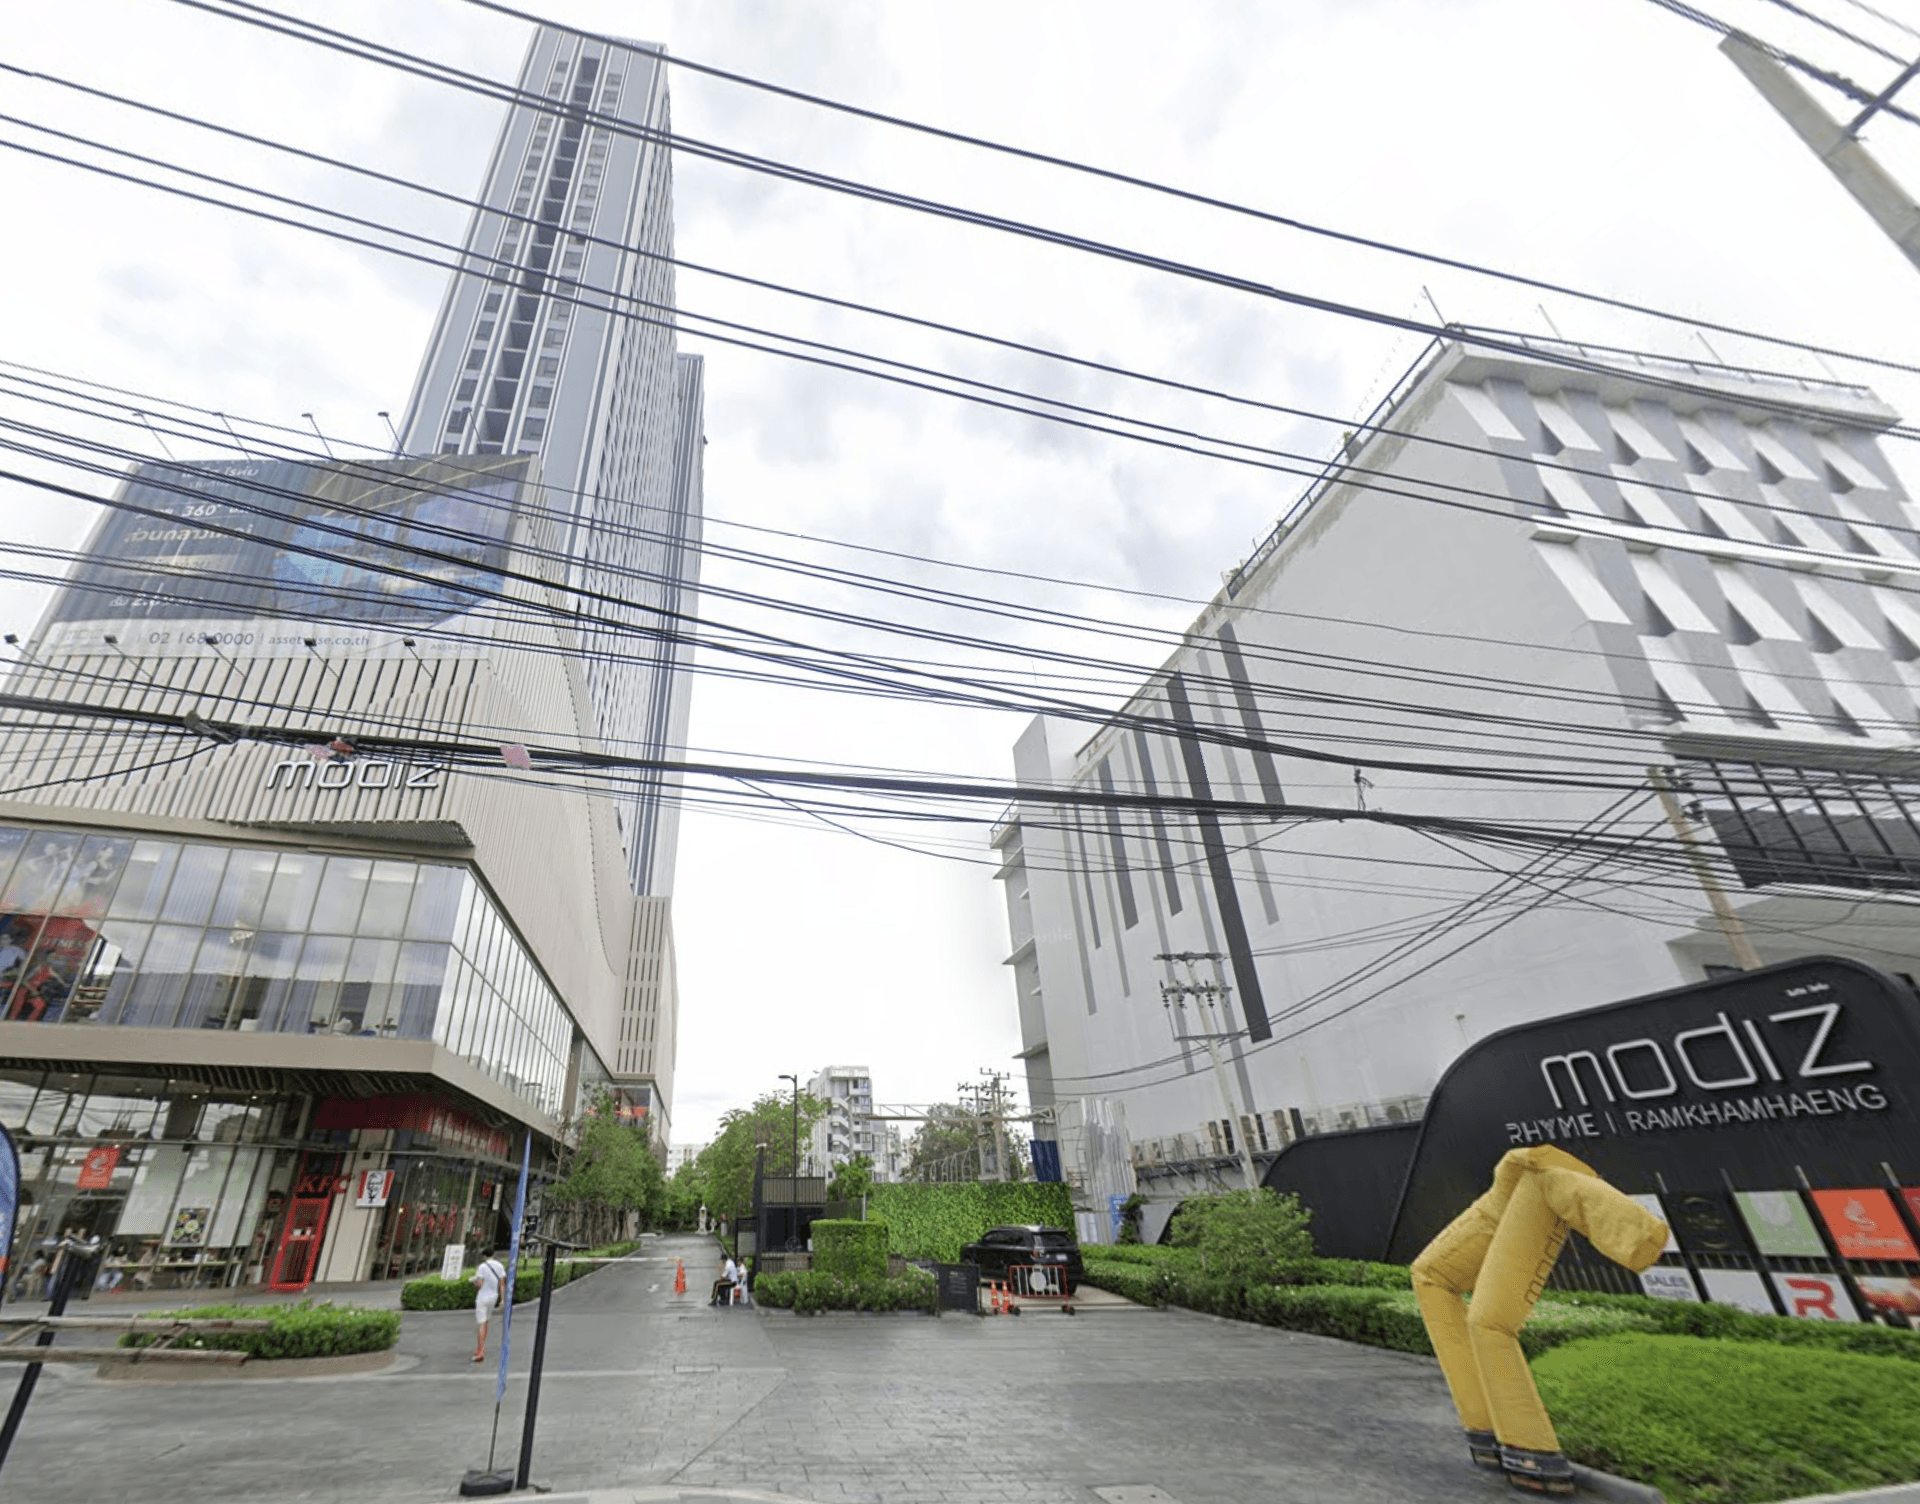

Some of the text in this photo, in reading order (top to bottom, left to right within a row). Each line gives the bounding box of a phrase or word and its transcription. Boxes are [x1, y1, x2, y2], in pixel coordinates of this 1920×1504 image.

[149, 632, 170, 645] 02
[215, 632, 254, 646] 0000
[267, 633, 370, 647] assetise.co.th
[1505, 1083, 1889, 1144] RHYME RAMKHAMHAENG
[298, 1173, 352, 1194] KFC
